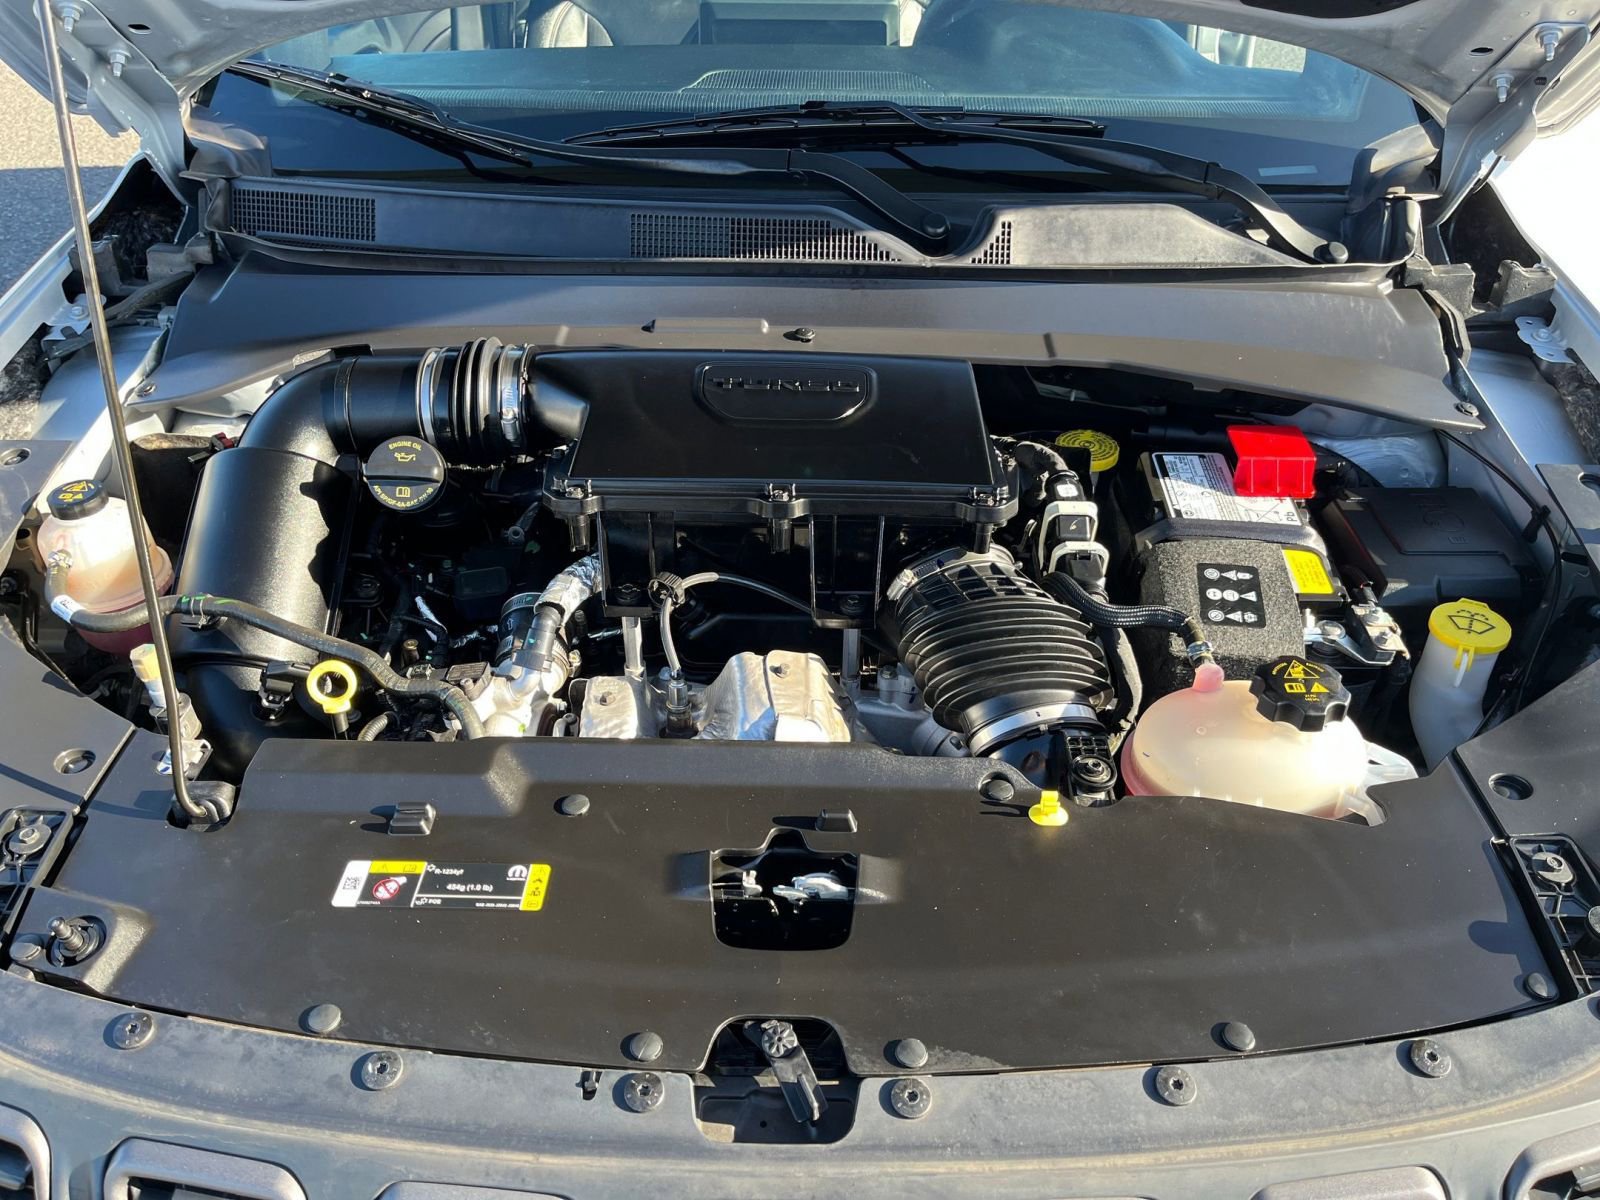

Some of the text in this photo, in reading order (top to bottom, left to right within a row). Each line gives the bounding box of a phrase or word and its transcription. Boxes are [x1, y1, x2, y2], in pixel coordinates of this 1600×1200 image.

[388, 441, 422, 451] ENGINE OIL
[1283, 511, 1298, 522] Pb
[482, 884, 494, 893] lb)
